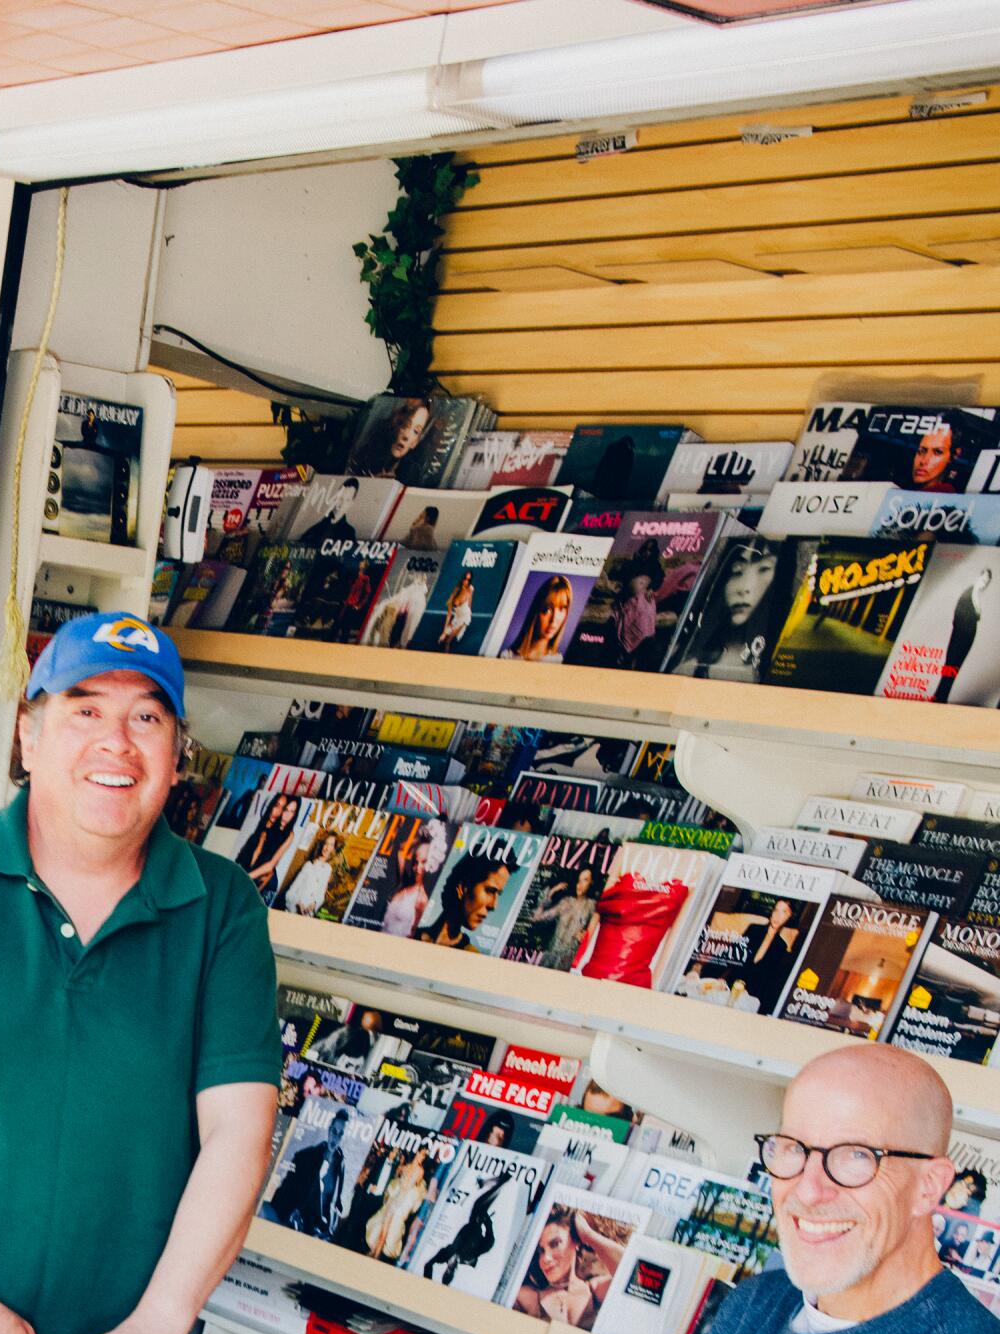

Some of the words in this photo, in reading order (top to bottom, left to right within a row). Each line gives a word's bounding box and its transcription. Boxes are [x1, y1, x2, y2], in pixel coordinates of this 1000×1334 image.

[493, 501, 558, 521] ACT
[321, 539, 352, 556] CAP
[766, 834, 847, 860] KONFEKT
[737, 862, 821, 893] KONFEKT
[898, 860, 964, 884] MONOCLE
[831, 899, 921, 929] MONOCLE
[940, 922, 1000, 950] MONO
[470, 1074, 505, 1099] THE
[506, 1081, 551, 1111] FACE
